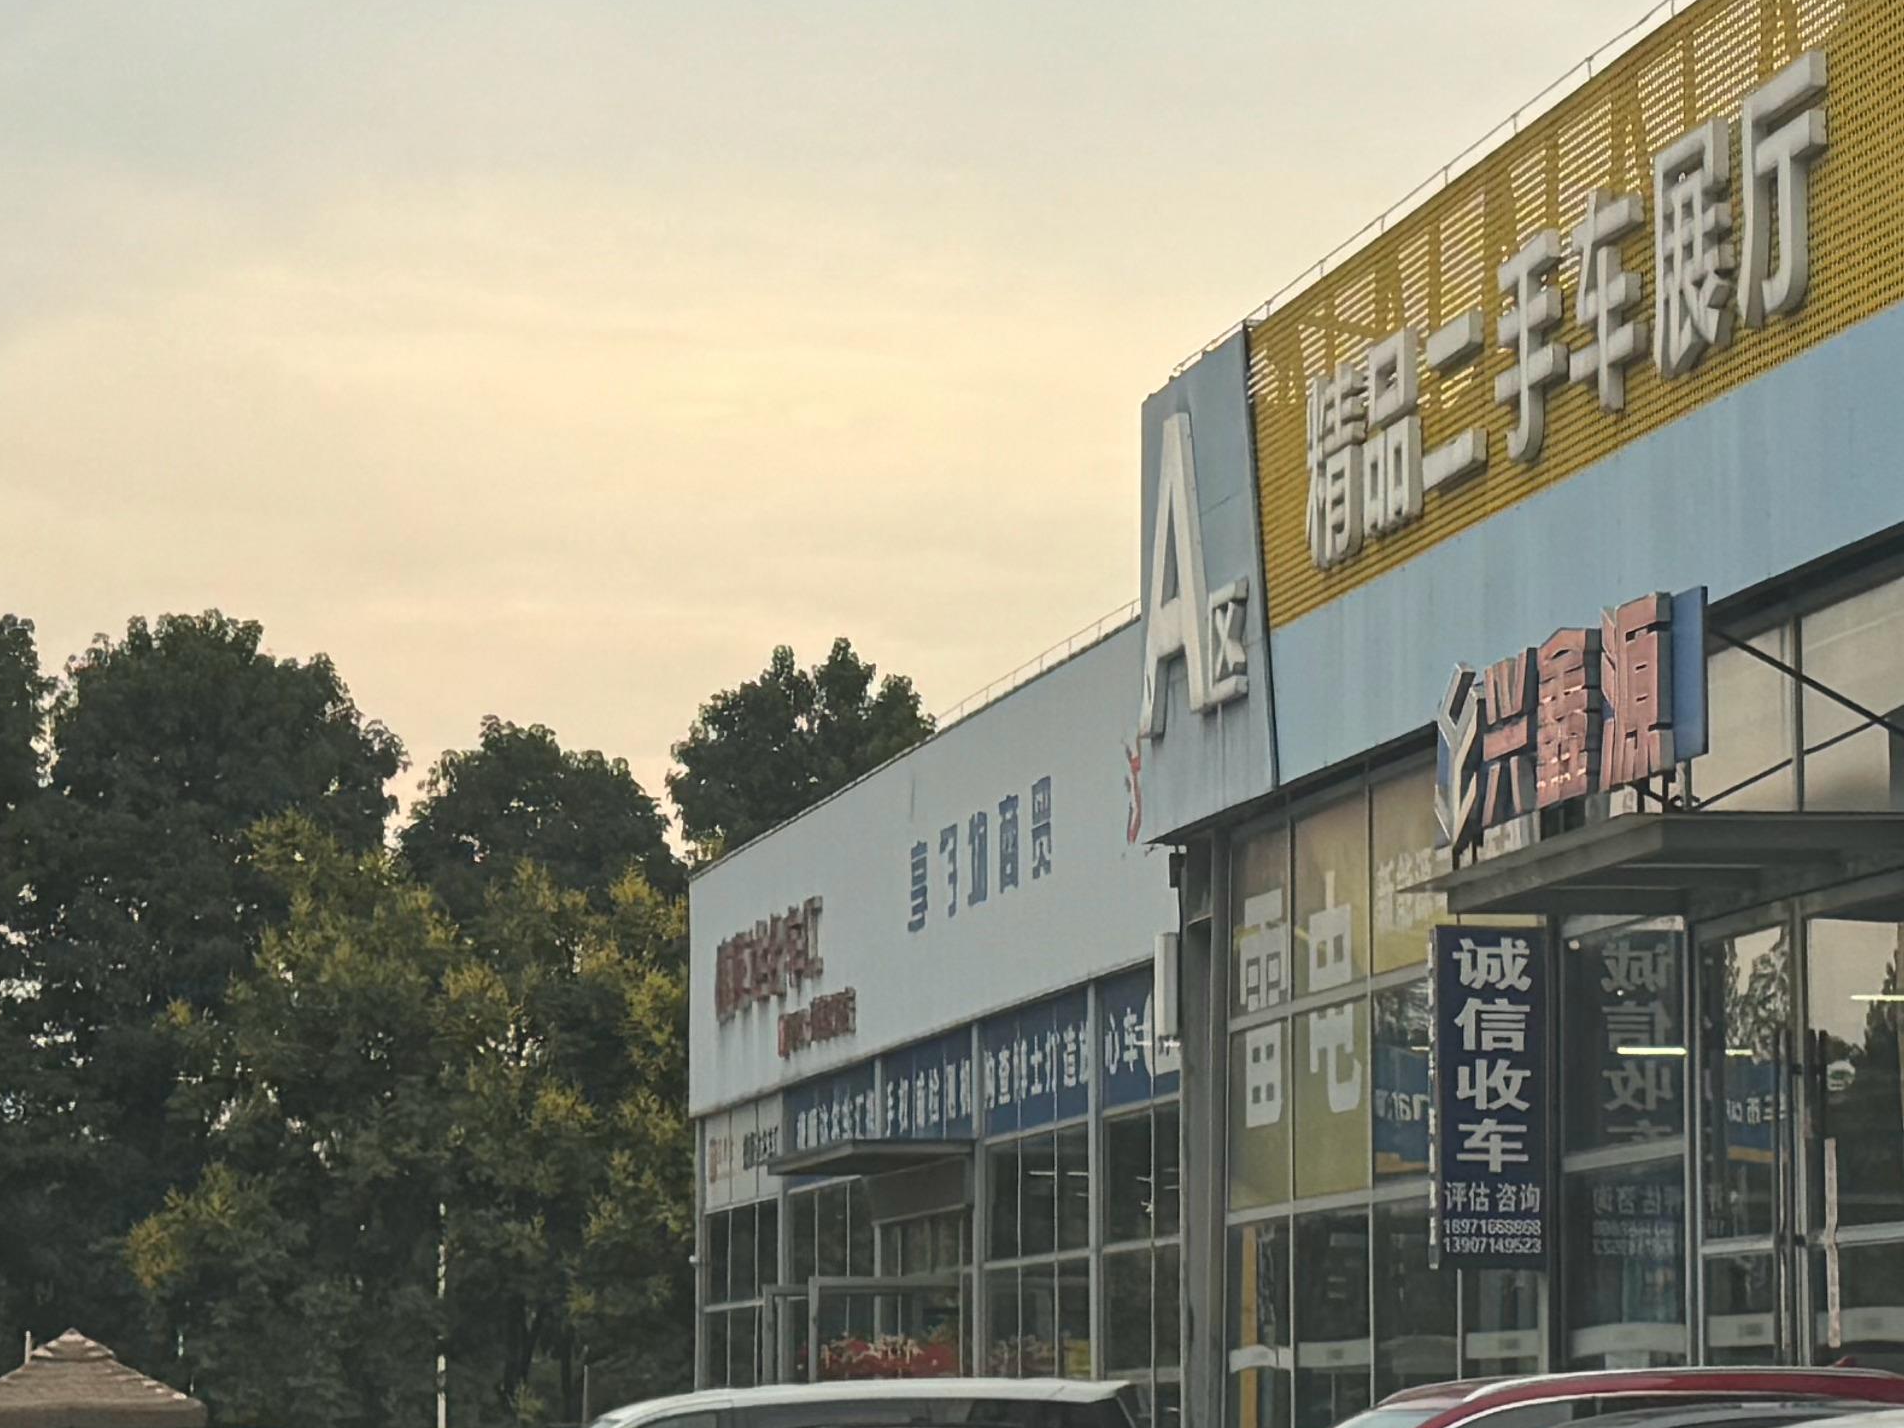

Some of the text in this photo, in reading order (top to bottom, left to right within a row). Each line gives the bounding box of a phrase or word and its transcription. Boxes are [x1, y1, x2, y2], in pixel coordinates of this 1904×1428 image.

[1305, 49, 1828, 569] 精品二手车展厅
[1140, 412, 1249, 740] A区
[1482, 591, 1672, 828] 兴鑫源
[1452, 937, 1533, 1173] 诚信收车
[1443, 1180, 1541, 1213] 评估 咨询
[1443, 1236, 1542, 1254] 13907149523
